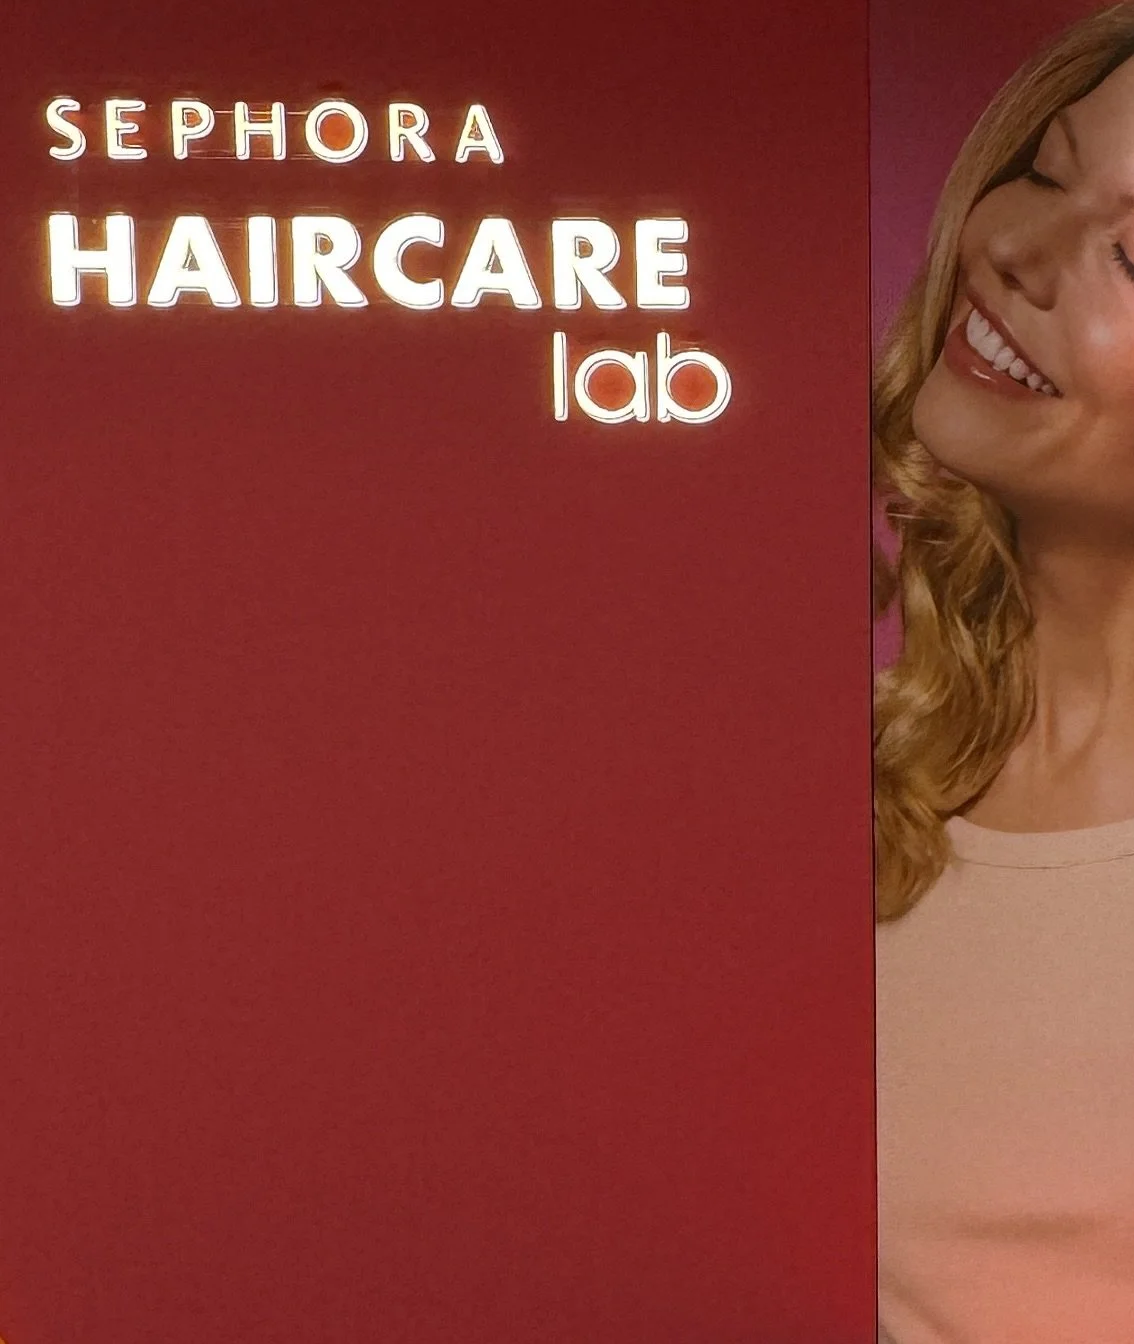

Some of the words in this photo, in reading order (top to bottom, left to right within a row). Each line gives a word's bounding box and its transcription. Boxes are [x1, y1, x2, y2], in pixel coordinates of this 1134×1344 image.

[46, 98, 505, 163] SEPHORA
[47, 213, 691, 311] HAIRCARE
[553, 331, 732, 424] lab
